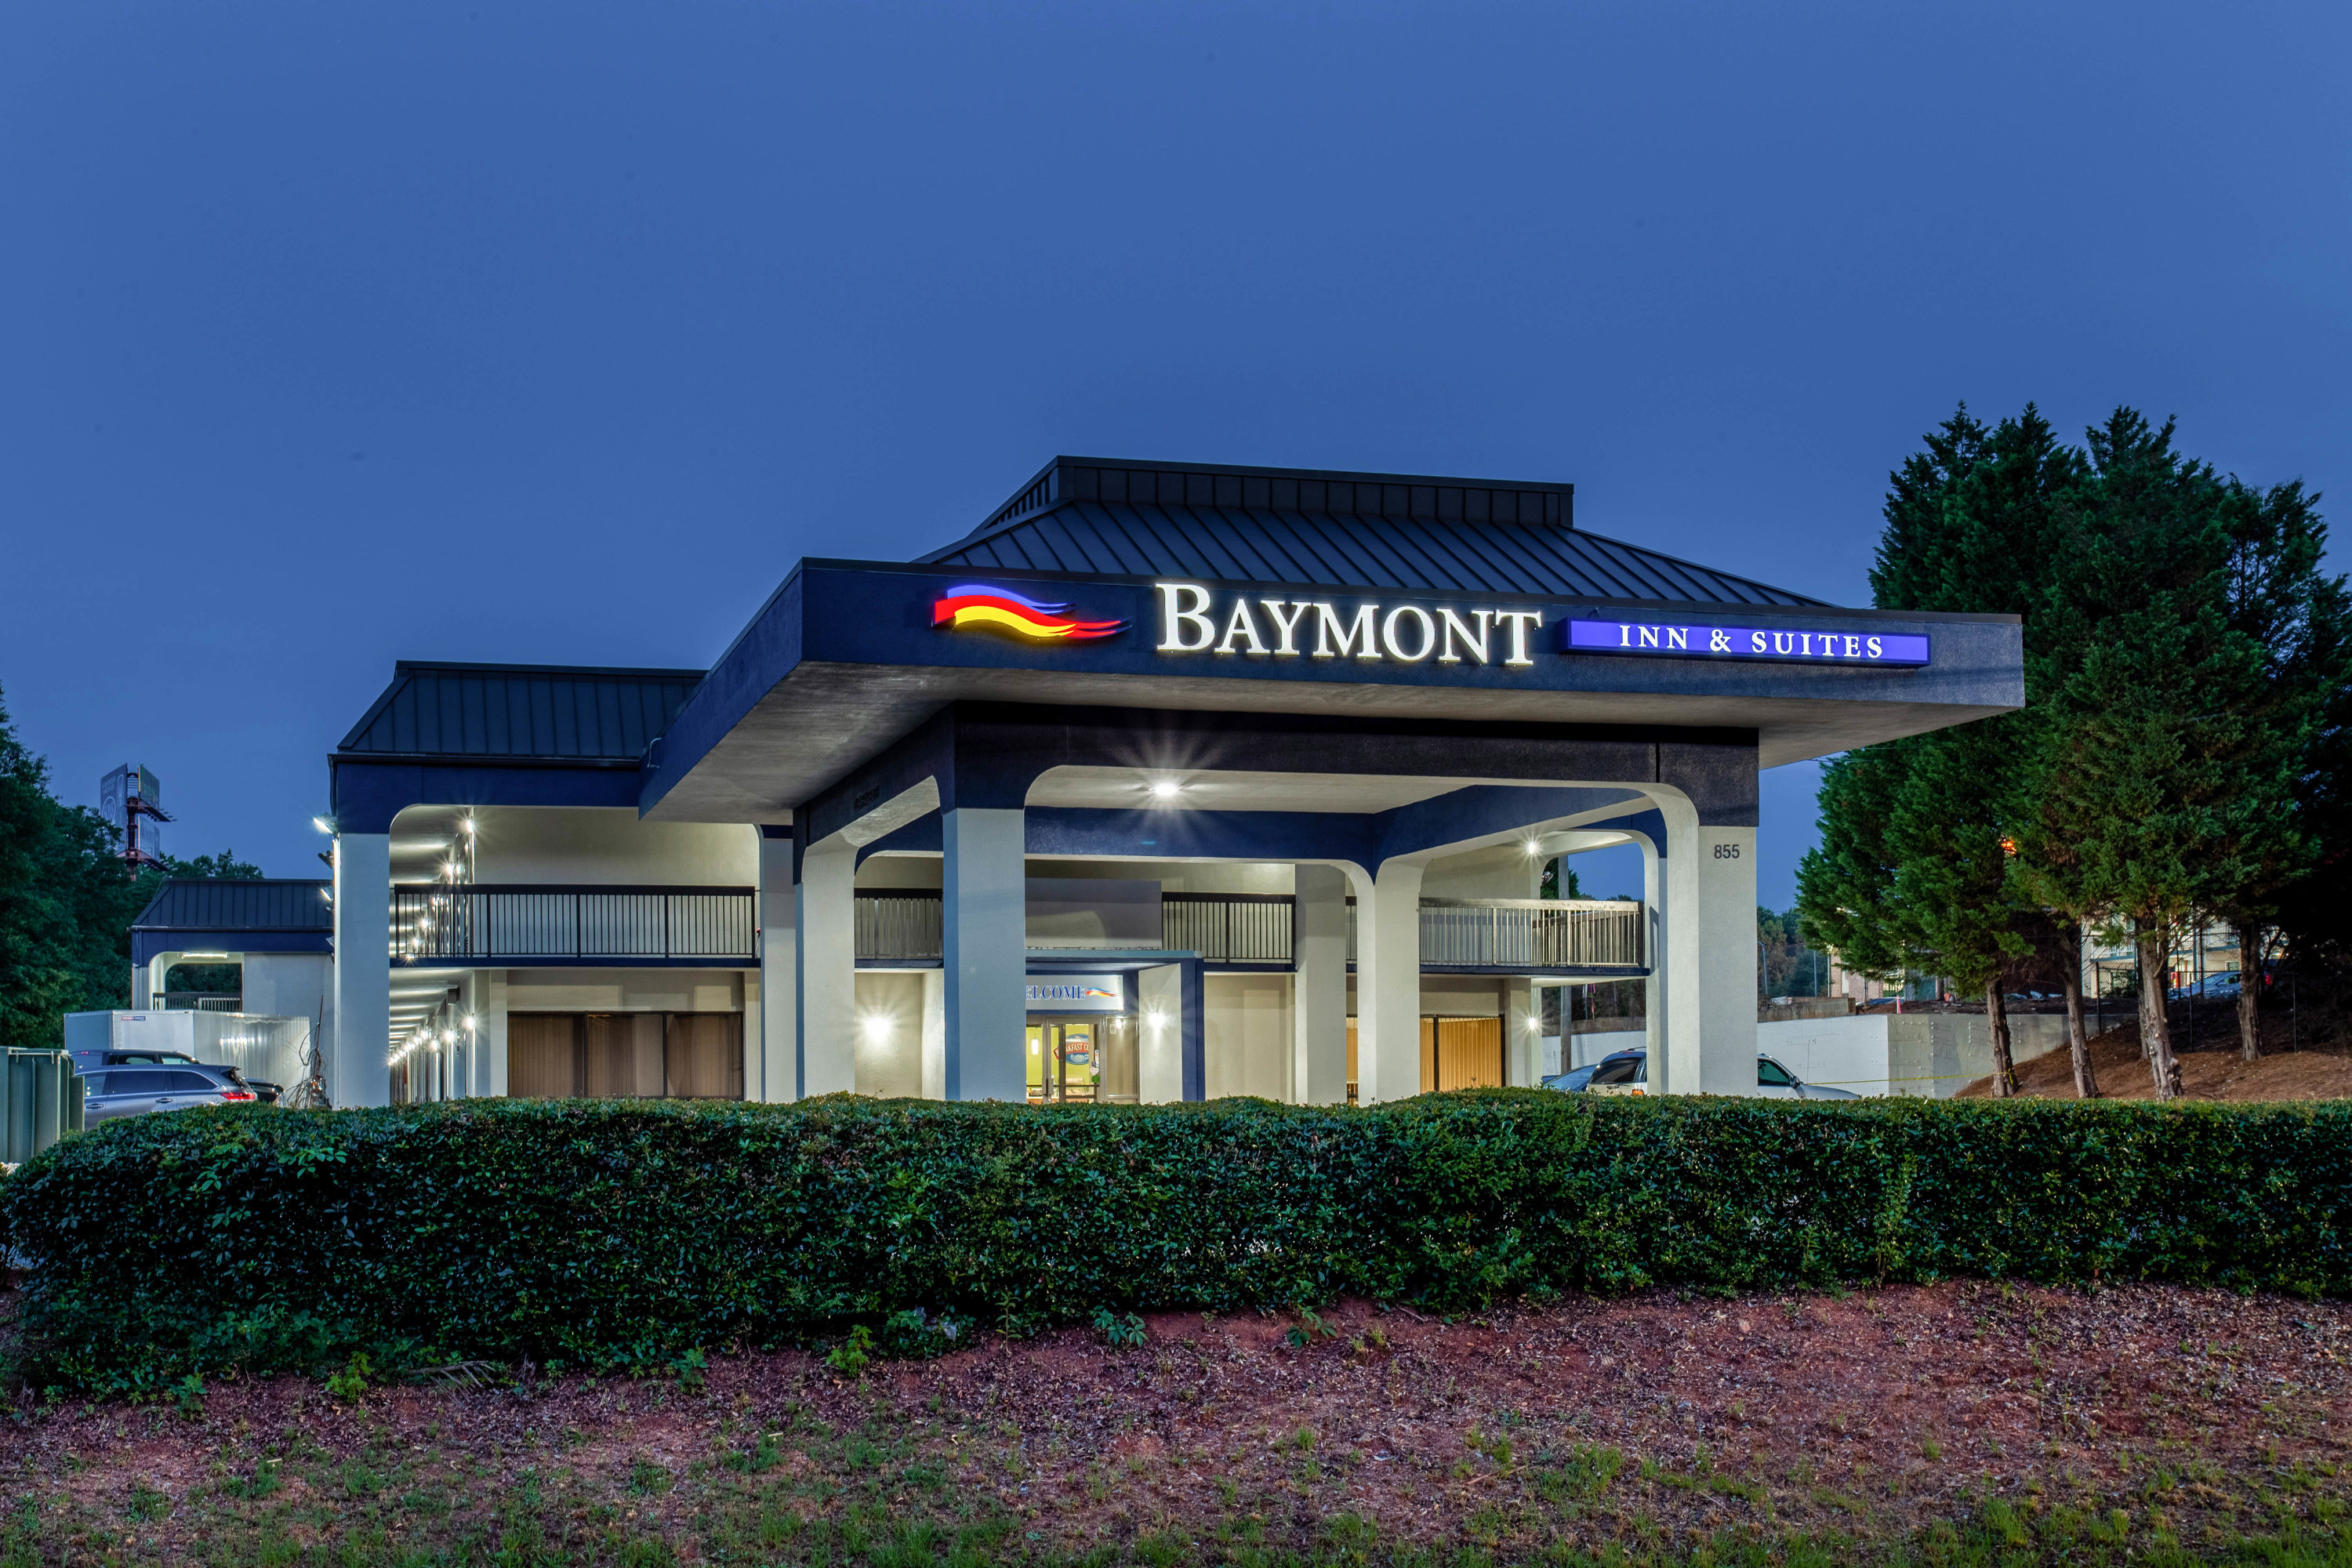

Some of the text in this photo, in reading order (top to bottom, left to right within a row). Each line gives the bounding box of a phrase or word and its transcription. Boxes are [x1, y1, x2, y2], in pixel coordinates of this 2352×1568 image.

[1155, 583, 1542, 666] BAYMONT
[1619, 625, 1883, 659] INN & SUITES
[1714, 844, 1740, 859] 855
[1025, 985, 1086, 1000] ELCOME
